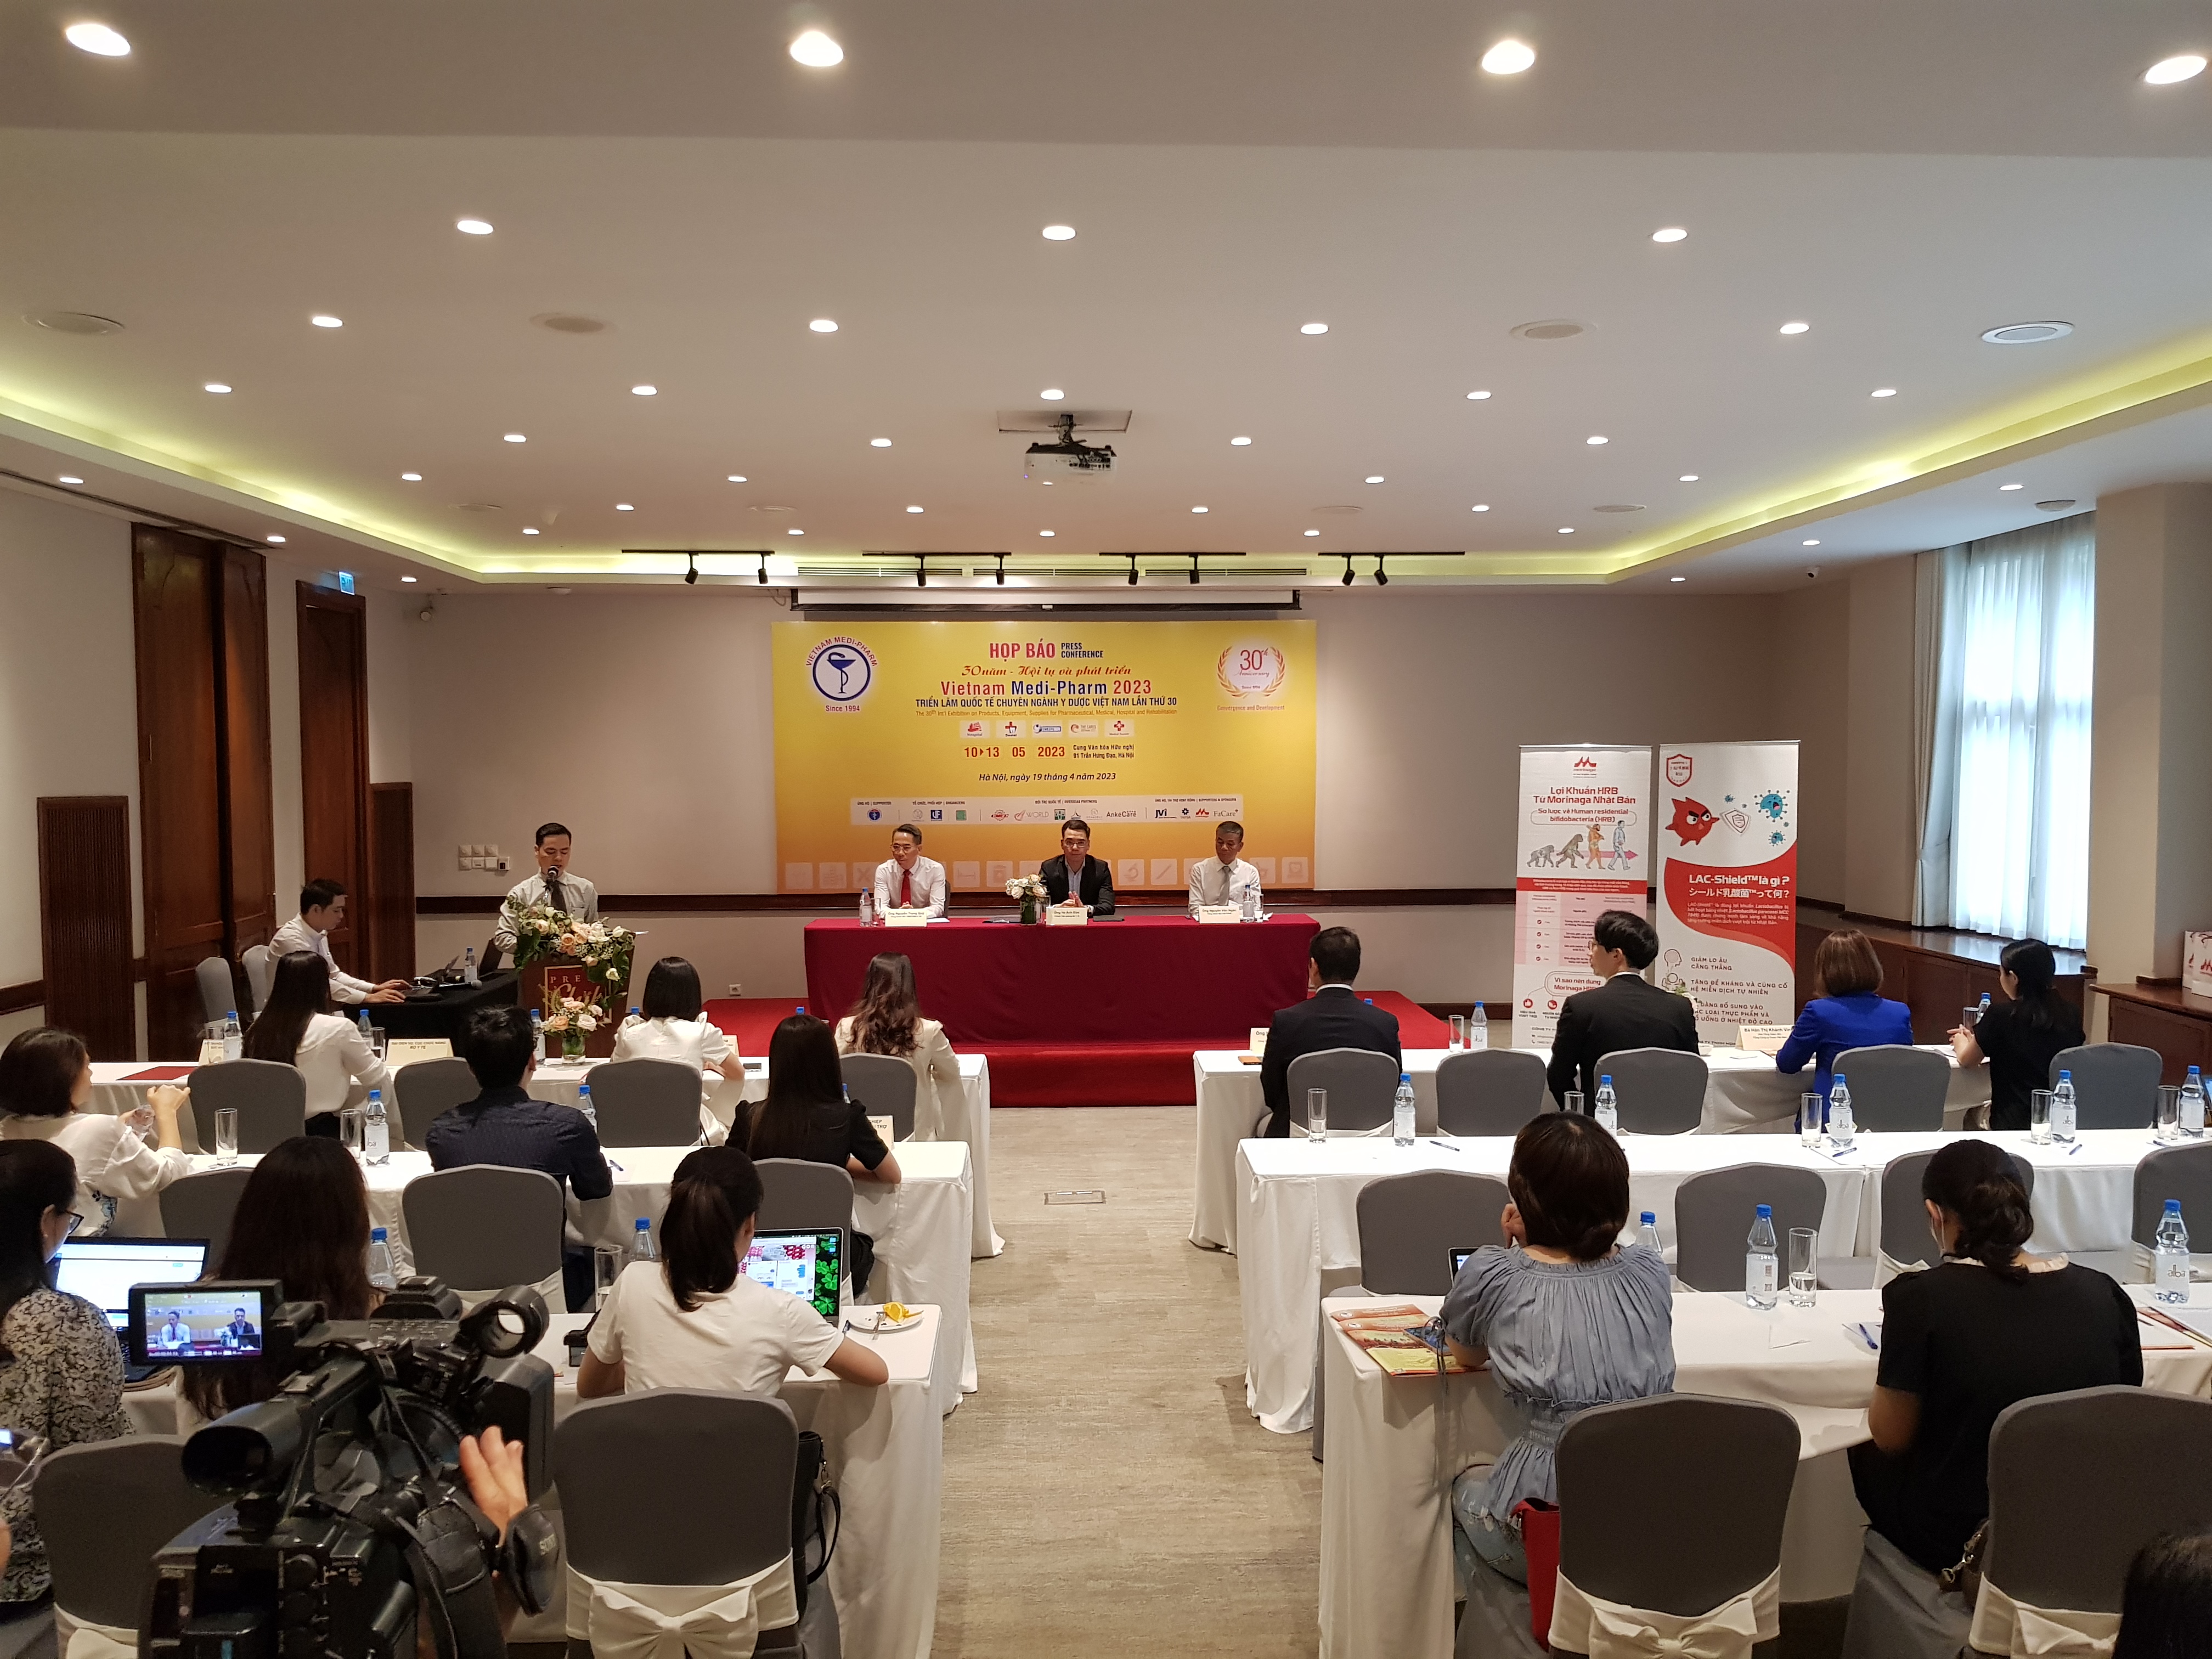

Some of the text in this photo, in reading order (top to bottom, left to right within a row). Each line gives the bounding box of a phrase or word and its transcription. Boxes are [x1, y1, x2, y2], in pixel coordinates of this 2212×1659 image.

[806, 636, 878, 667] VIETNAM MEDI-PHARM
[990, 638, 1056, 662] HỌP BÁO
[1018, 665, 1041, 678] Hội
[1043, 666, 1056, 677] tụ
[1059, 666, 1072, 675] và
[1075, 665, 1102, 677] phát
[941, 680, 1152, 696] Vietnam Medi-Pharm 2023
[916, 695, 1177, 709] TRIỂN LÃM QUỐC TẾ CHUYÊN NGÀNH Y DƯỢC VIỆT NAM LẦN THỨ 30
[964, 746, 1065, 758] 10 13 05 2023
[992, 774, 1008, 782] Nội,
[1010, 774, 1030, 782] ngày
[1043, 773, 1068, 782] tháng
[1550, 787, 1565, 796] Lợi
[1547, 796, 1591, 805] Morinaga
[1759, 876, 1770, 885] là
[1837, 1120, 1849, 1129] alba
[2168, 1265, 2186, 1278] alba
